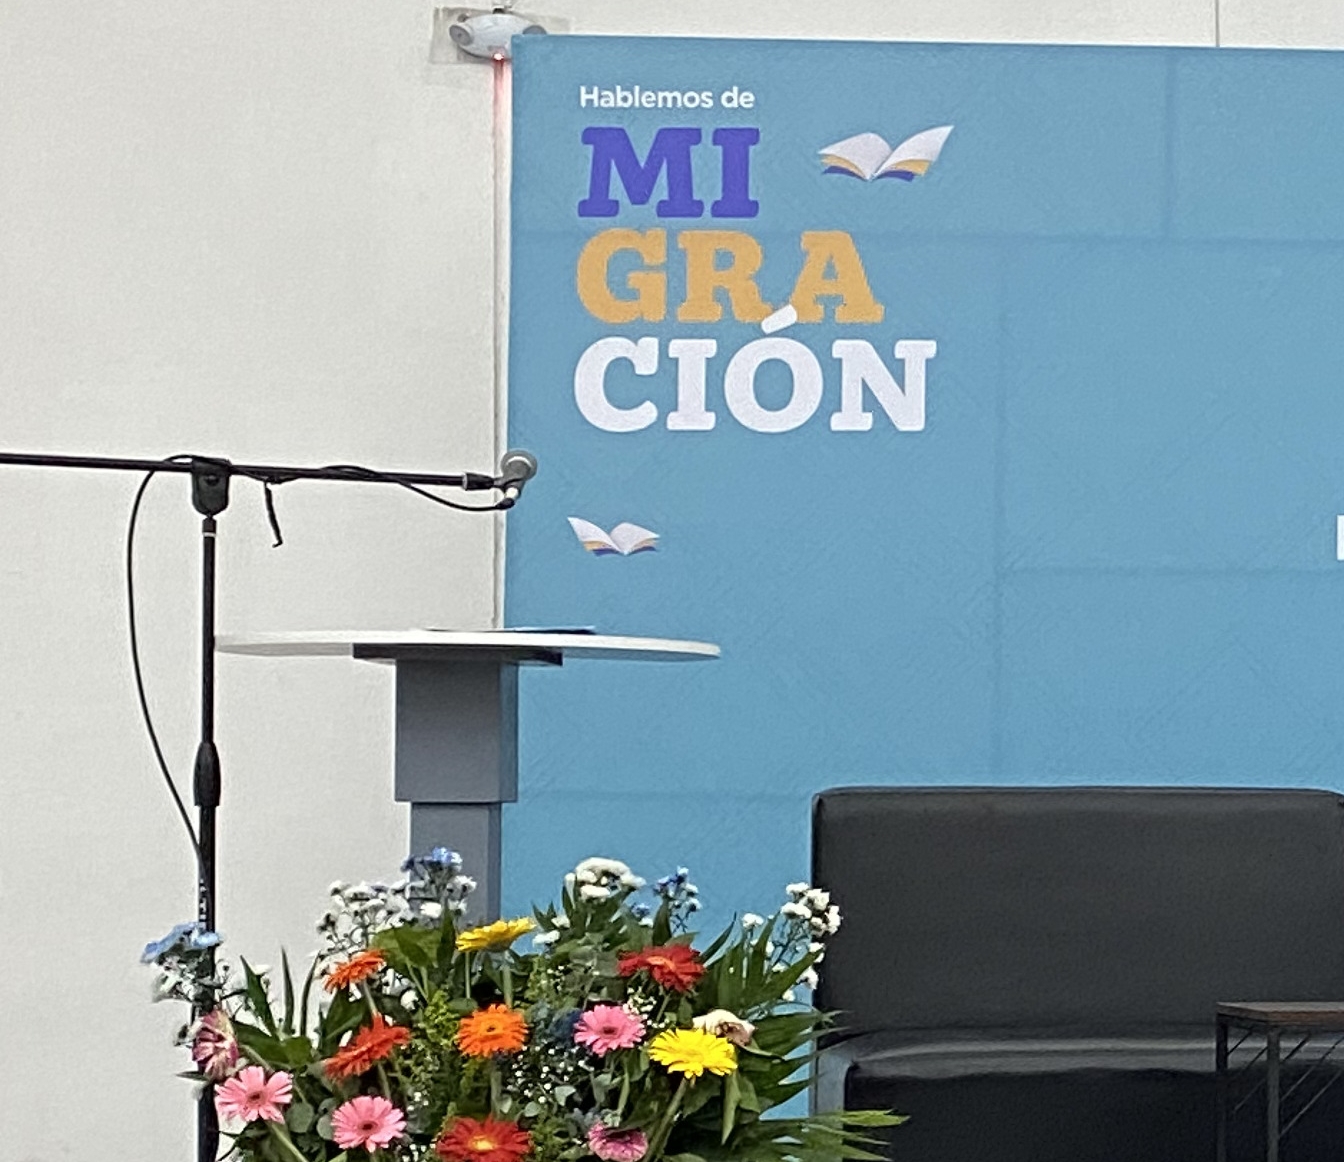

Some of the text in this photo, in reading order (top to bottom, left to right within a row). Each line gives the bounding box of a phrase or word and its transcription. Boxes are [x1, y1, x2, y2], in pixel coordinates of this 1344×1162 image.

[580, 85, 755, 109] Hablemos de
[577, 127, 760, 218] MI
[576, 228, 885, 323] GRA
[574, 304, 938, 433] CIÓN
